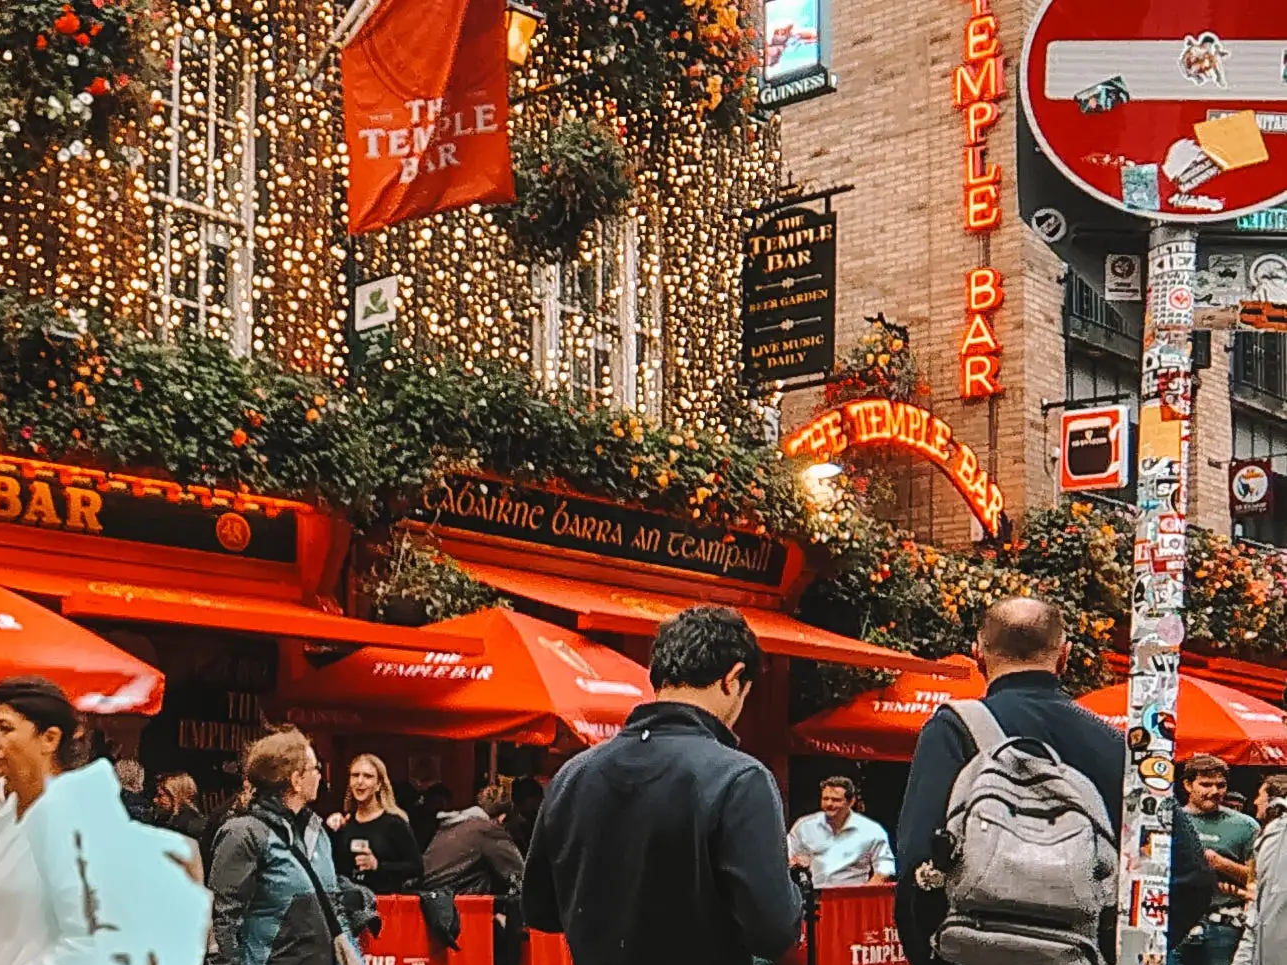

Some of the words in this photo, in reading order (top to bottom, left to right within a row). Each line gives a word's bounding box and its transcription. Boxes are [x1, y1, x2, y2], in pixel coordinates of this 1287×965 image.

[760, 73, 826, 105] GUINNESS
[954, 0, 1005, 231] EMPLE
[775, 214, 805, 231] THE
[749, 224, 834, 256] TEMPLE
[764, 249, 813, 273] BAR
[780, 288, 830, 308] GARDEN
[751, 341, 780, 358] LIVE
[783, 333, 825, 353] MUSIC
[960, 267, 1004, 396] BAR
[767, 351, 808, 369] DAILY
[848, 398, 952, 461] TEMPLE
[956, 443, 1006, 538] BAR
